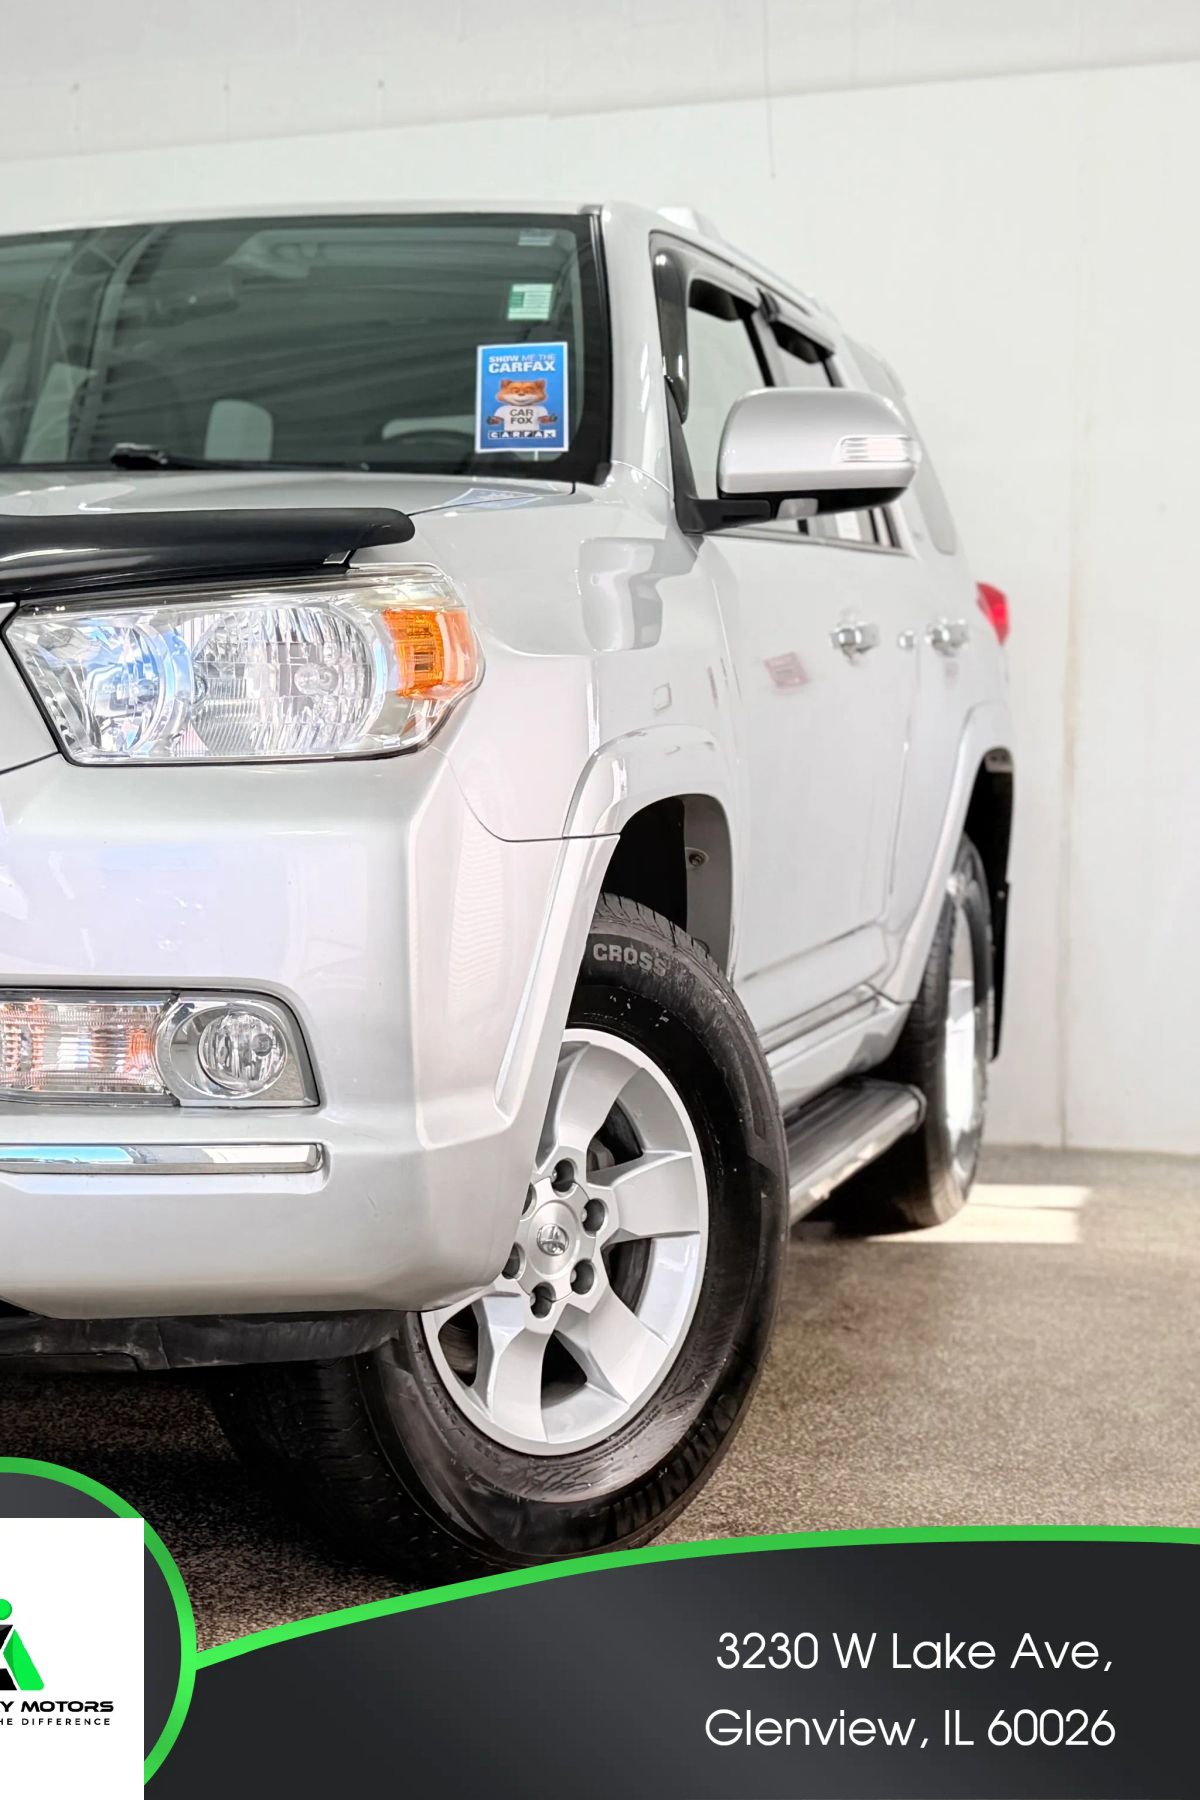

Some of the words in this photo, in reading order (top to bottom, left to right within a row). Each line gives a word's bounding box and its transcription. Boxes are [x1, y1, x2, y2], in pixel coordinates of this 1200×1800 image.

[488, 354, 520, 363] SHOW
[488, 360, 556, 374] CARFAX
[510, 408, 534, 417] CAR
[510, 416, 533, 425] FOX
[489, 430, 557, 439] CARFAX
[593, 943, 667, 977] CROSS
